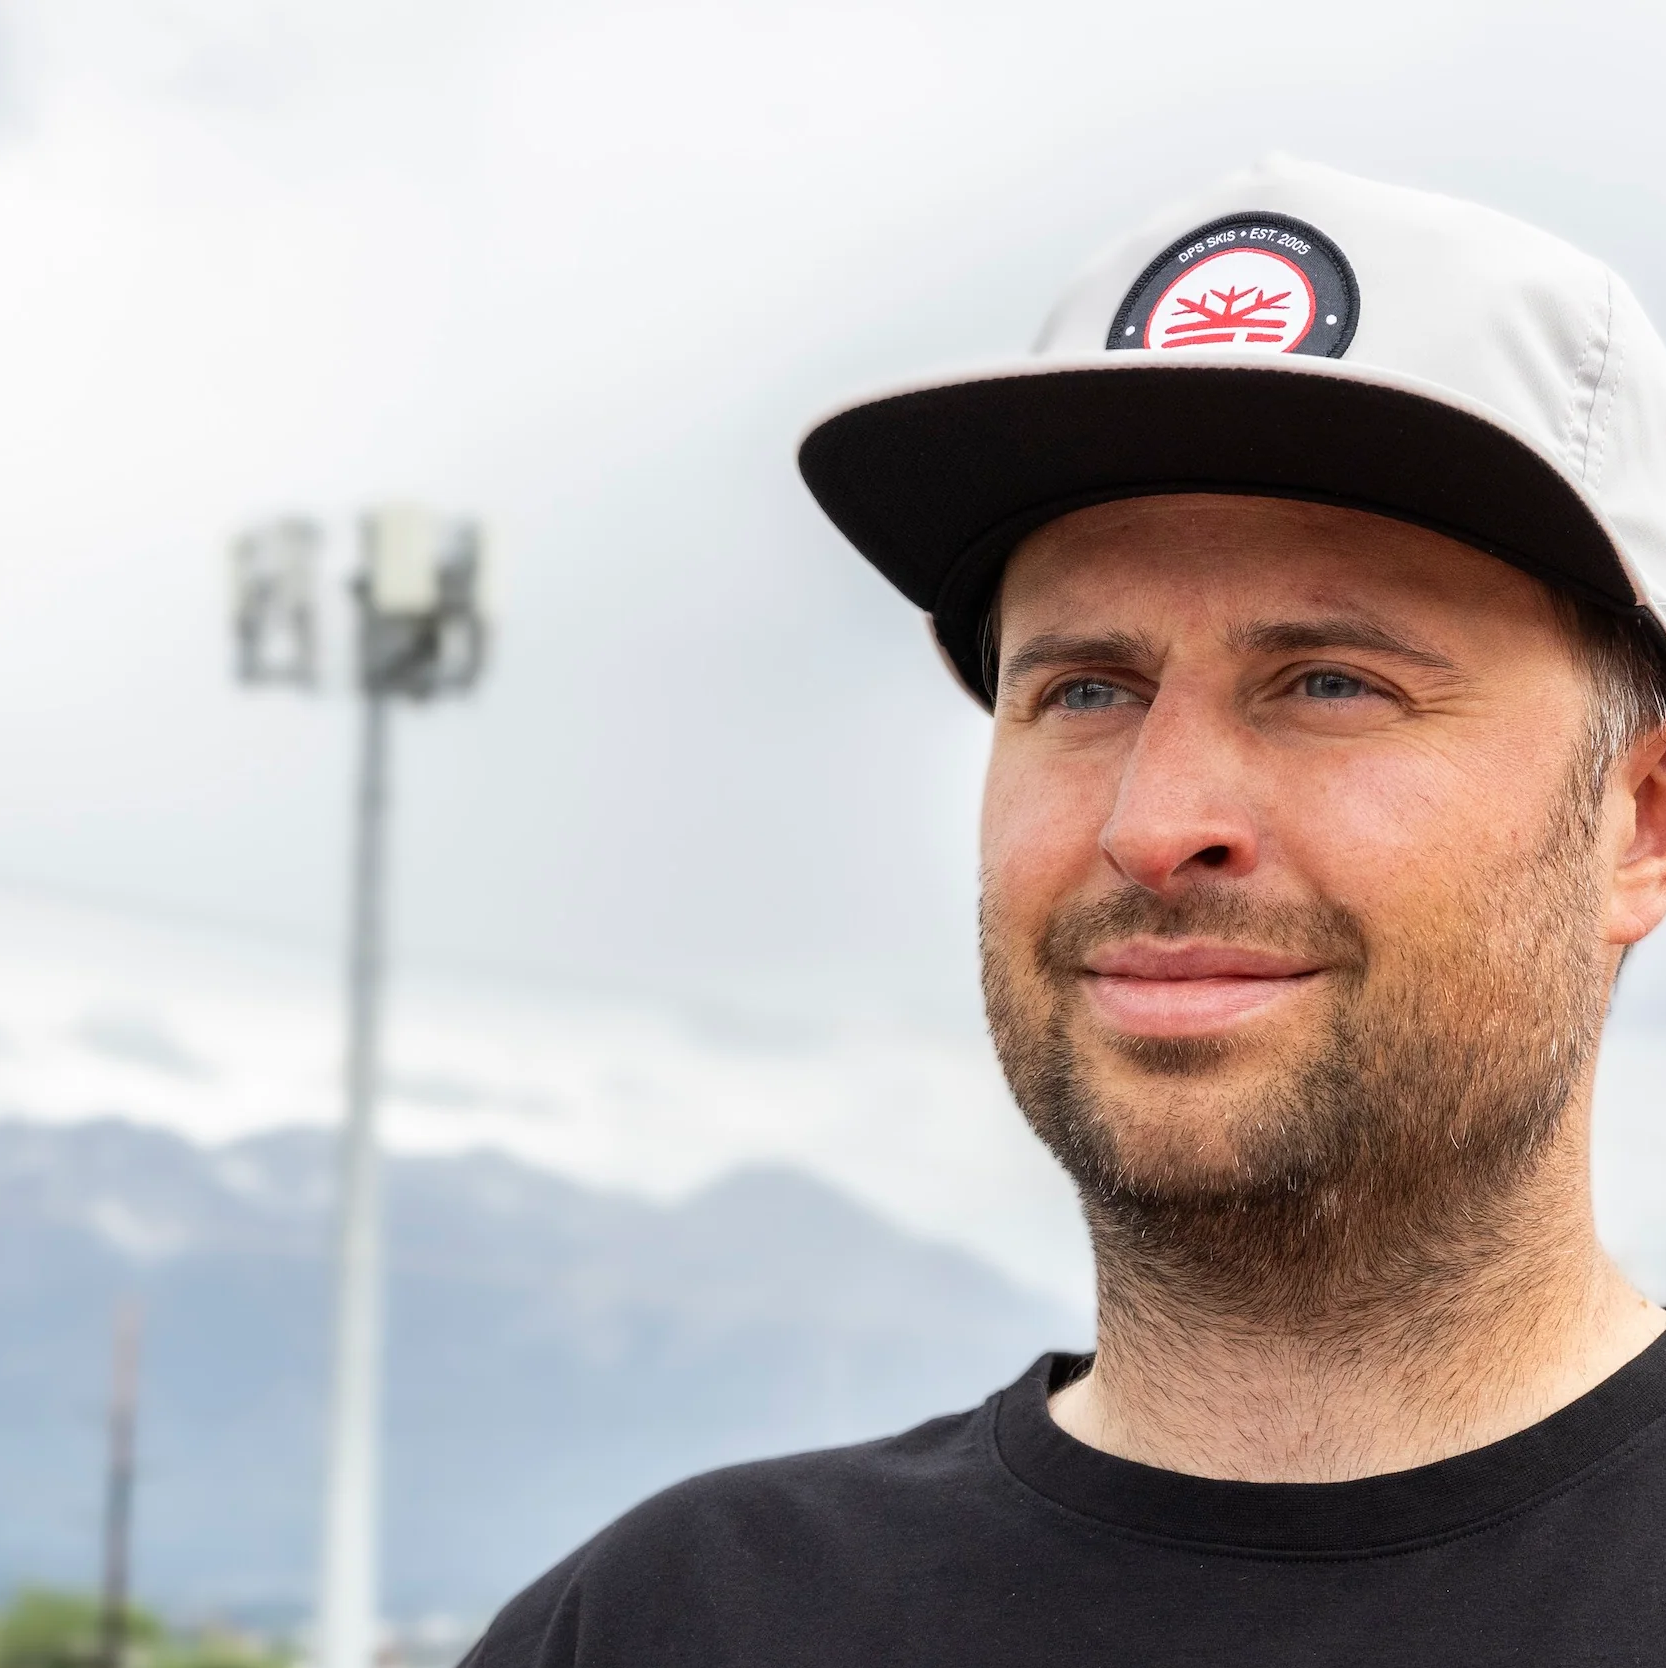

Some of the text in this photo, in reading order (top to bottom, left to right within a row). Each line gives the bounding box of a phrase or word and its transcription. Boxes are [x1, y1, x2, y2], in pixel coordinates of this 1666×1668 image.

[1178, 227, 1311, 263] DPS SKIS EST. 2005
